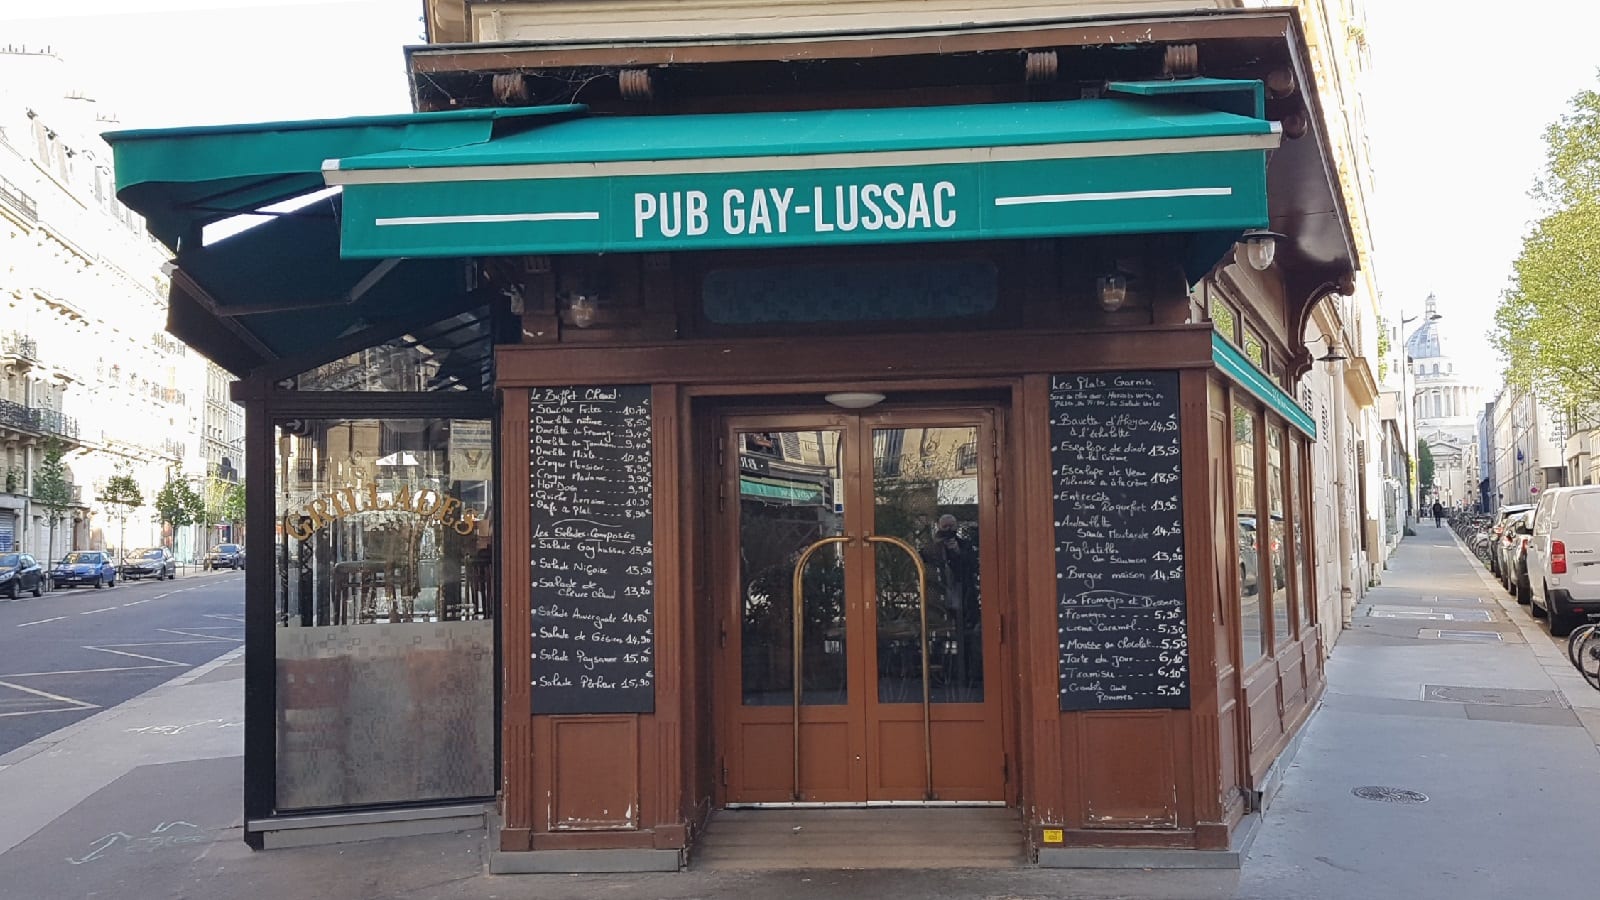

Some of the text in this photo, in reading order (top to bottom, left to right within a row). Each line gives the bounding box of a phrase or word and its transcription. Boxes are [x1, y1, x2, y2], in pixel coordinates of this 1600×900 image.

[634, 181, 956, 238] PUB GAY-LUSSAC
[1053, 376, 1072, 389] Les
[1076, 376, 1106, 389] Plats
[531, 388, 541, 400] Le
[543, 388, 577, 405] Buffet
[1109, 443, 1120, 452] de
[1061, 465, 1104, 479] Escalope
[1109, 466, 1121, 476] de
[285, 483, 479, 541] GRILLADES
[1101, 500, 1147, 517] Roquefort
[533, 524, 549, 538] Les
[539, 541, 571, 550] Salade
[540, 558, 569, 570] Salade
[539, 576, 597, 589] Salade de
[1066, 565, 1104, 589] Burger
[1112, 571, 1145, 579] maison
[1061, 593, 1077, 605] Les
[1128, 597, 1139, 605] et
[538, 604, 568, 618] Salade
[539, 626, 569, 639] Salade
[574, 631, 586, 641] de
[1067, 639, 1101, 650] Mousse
[539, 649, 568, 661] Salade
[1064, 653, 1088, 663] Tarte
[539, 673, 573, 688] Salade
